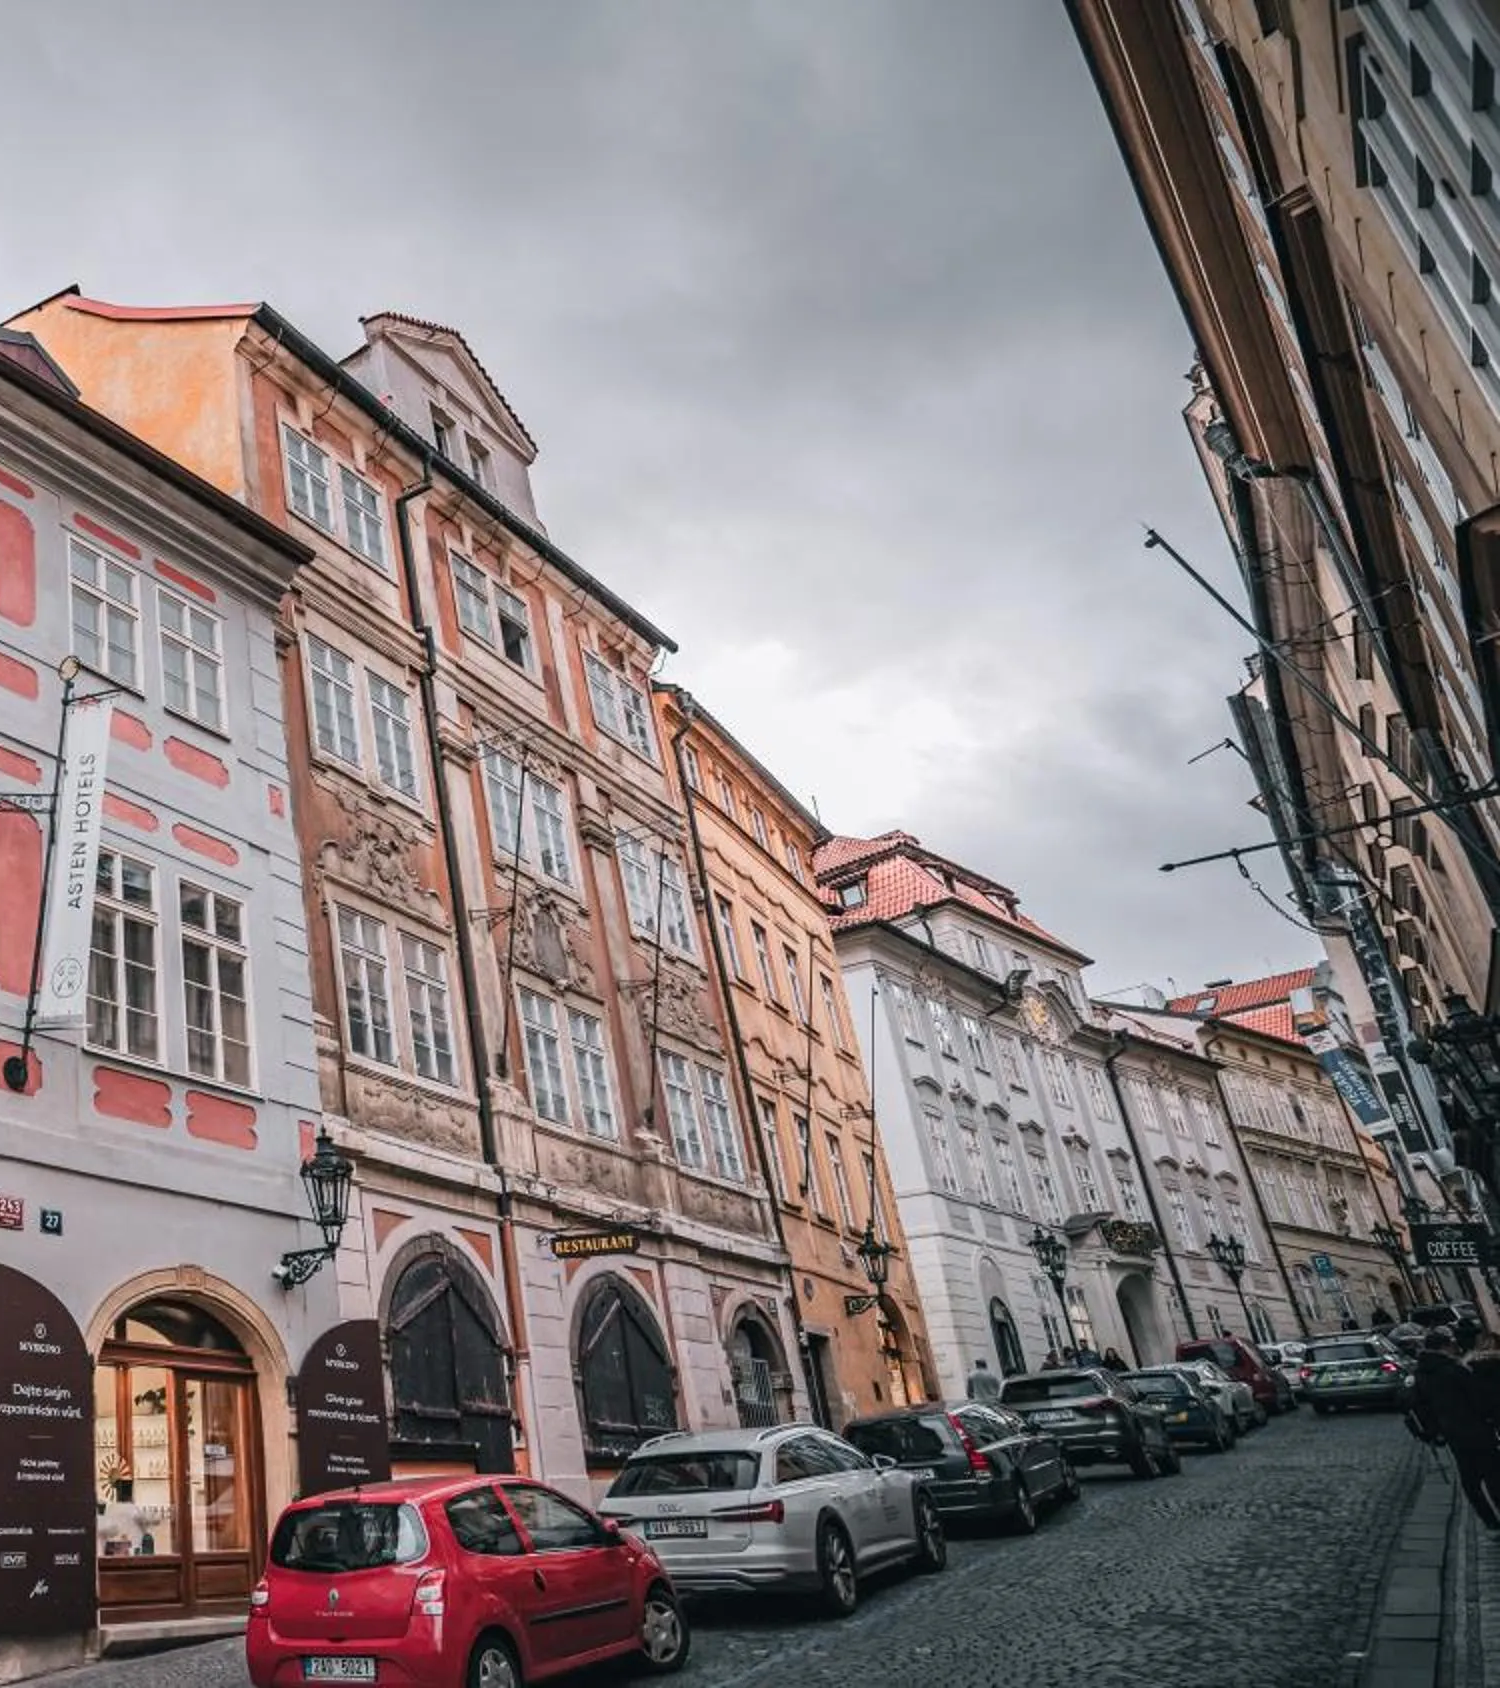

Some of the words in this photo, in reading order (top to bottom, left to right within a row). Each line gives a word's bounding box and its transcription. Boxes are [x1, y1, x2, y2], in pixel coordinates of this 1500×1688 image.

[74, 752, 96, 833] HOTELS
[67, 841, 88, 910] ASTEN
[0, 1199, 21, 1213] 243
[45, 1215, 60, 1229] 27
[555, 1235, 634, 1253] RESTAURANT
[1427, 1241, 1479, 1257] COFFEE
